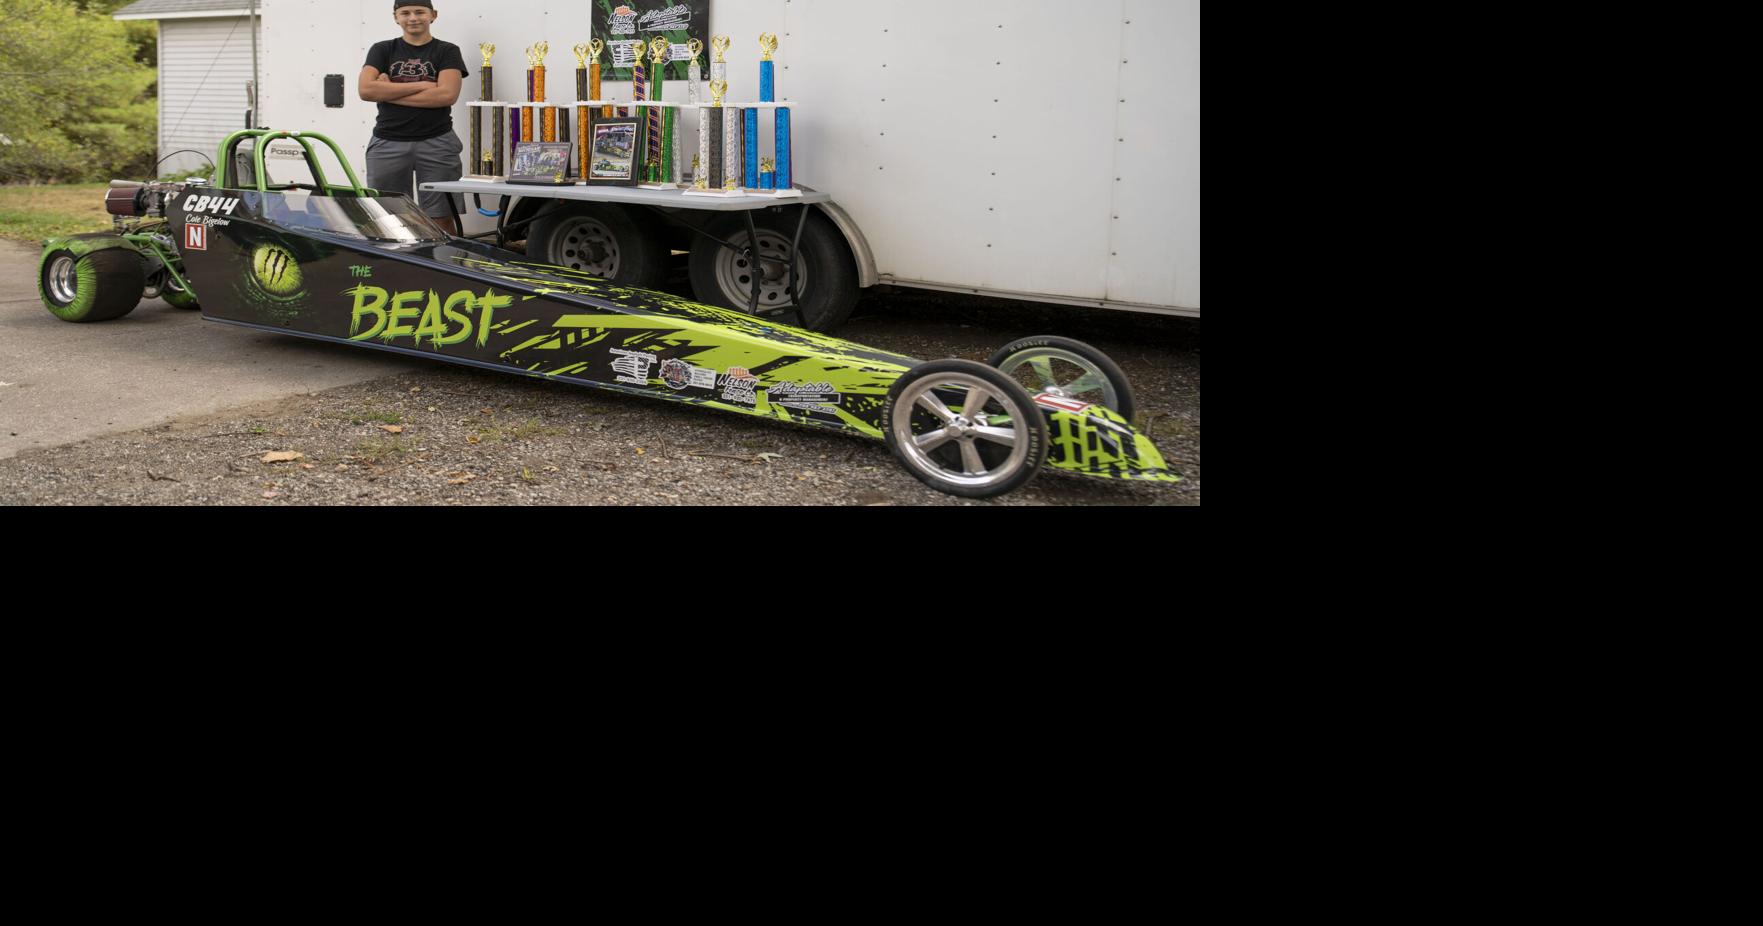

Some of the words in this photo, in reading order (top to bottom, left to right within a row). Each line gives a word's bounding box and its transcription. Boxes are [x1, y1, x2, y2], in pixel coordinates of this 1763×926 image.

[183, 194, 240, 215] CB44
[186, 214, 201, 223] Cole
[203, 215, 231, 227] Bigelow
[190, 226, 202, 247] N
[349, 265, 372, 277] THE
[341, 282, 513, 351] BEAST
[717, 374, 757, 390] NELSON
[767, 382, 834, 395] Adaptable
